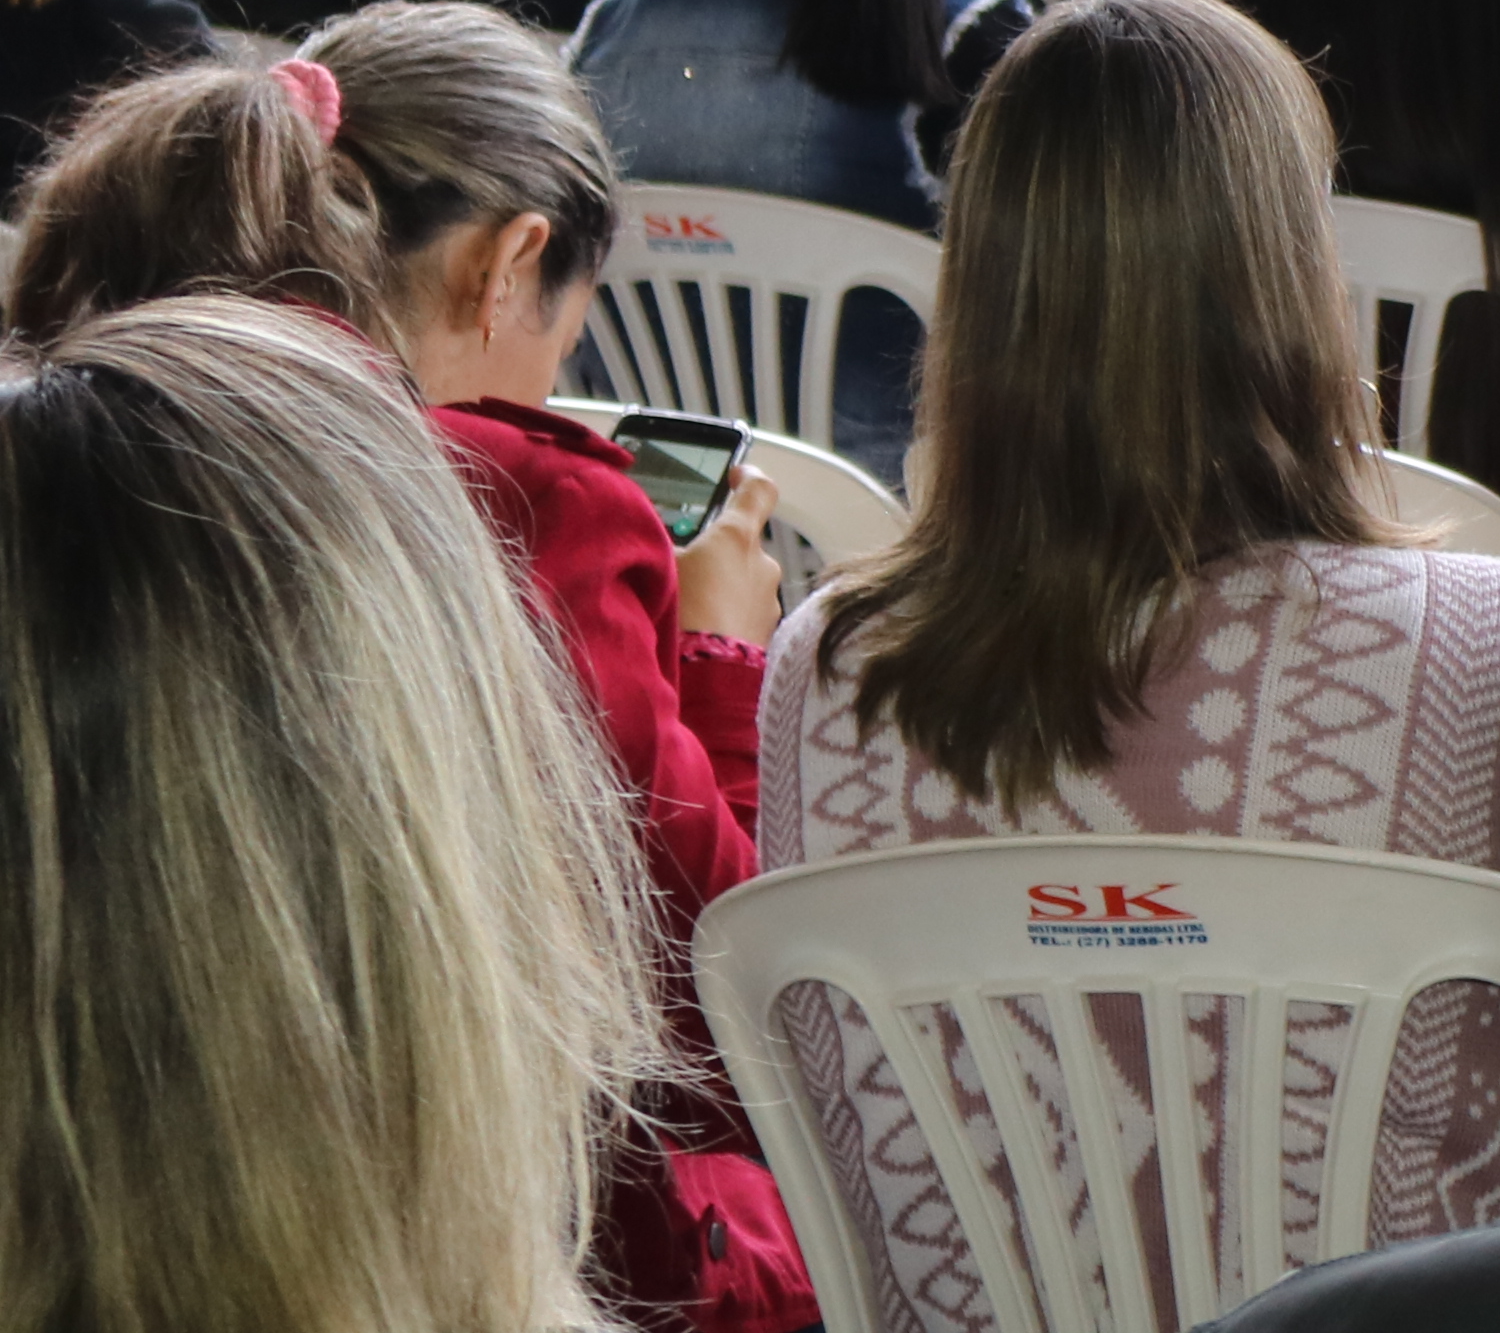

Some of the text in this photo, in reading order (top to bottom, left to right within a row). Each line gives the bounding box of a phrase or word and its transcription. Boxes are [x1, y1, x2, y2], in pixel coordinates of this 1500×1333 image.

[644, 213, 725, 240] SK
[1026, 882, 1189, 918] SK
[1027, 923, 1110, 935] DISTRIBUIDORA
[1112, 924, 1126, 935] DE
[1128, 924, 1174, 935] BEBIDAS
[1029, 934, 1208, 948] TEL.: (27) 3288-1170
